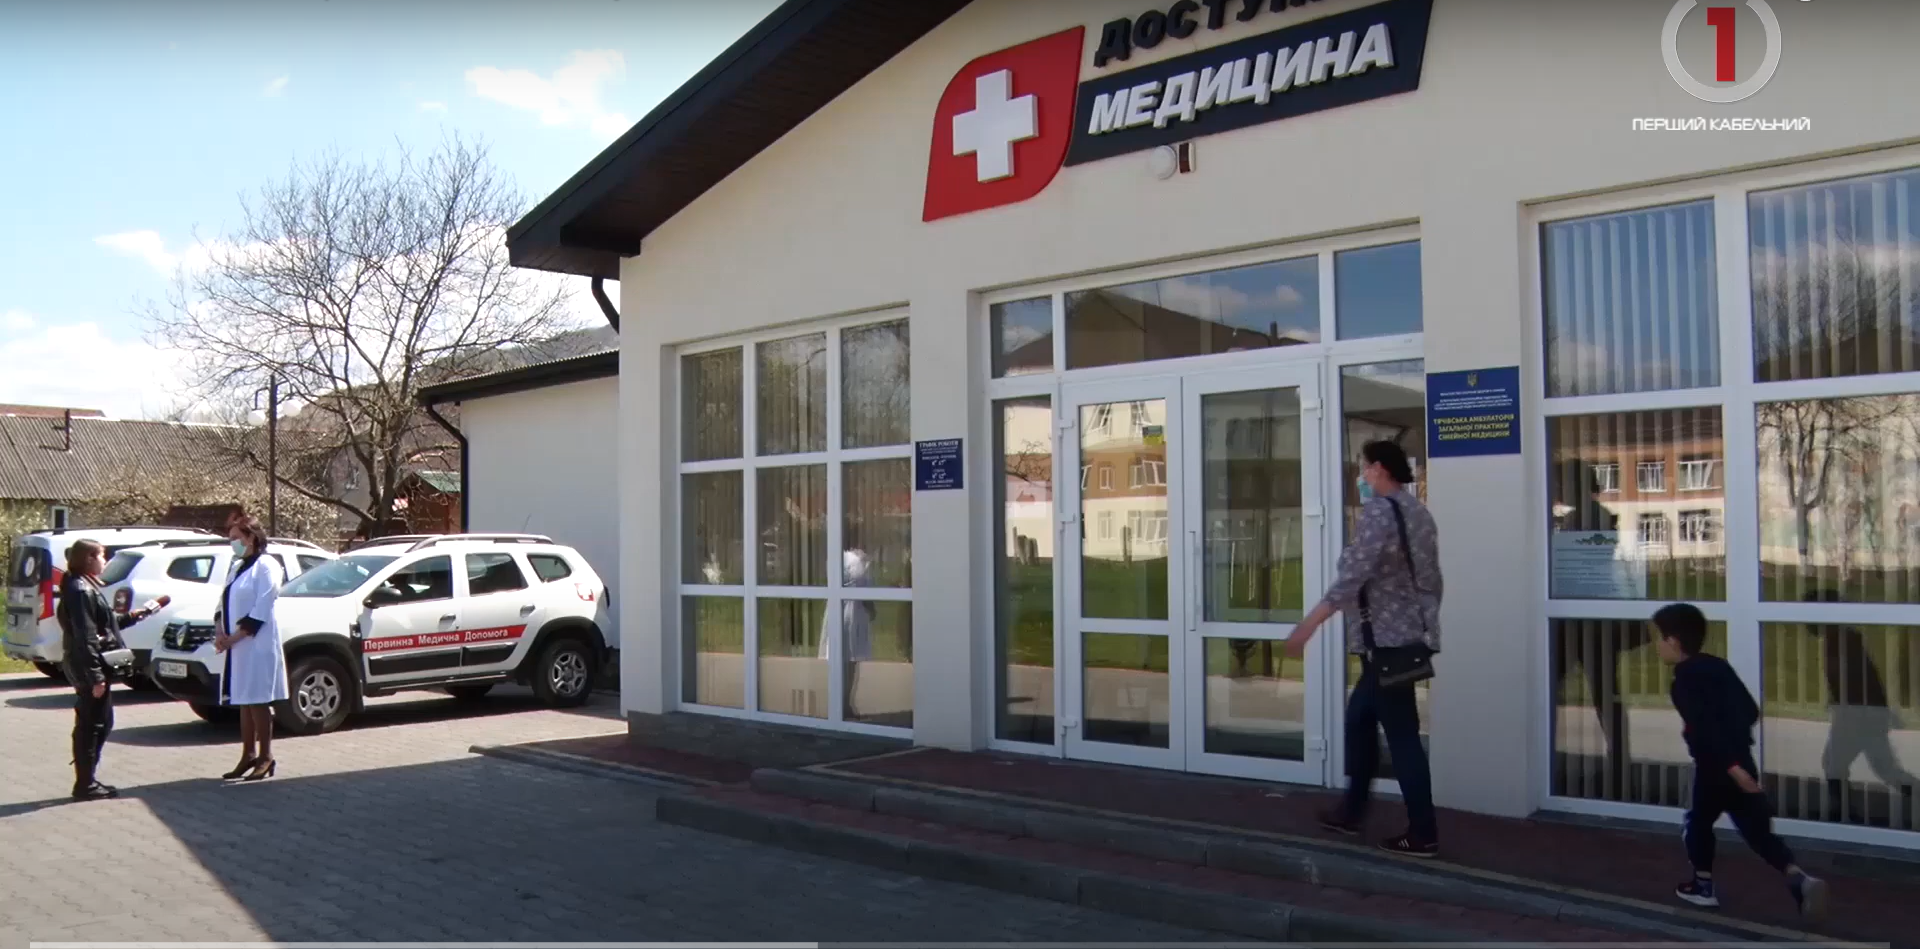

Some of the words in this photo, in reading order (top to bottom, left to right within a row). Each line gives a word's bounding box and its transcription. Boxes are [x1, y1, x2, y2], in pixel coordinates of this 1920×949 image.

[1088, 23, 1395, 135] МЕДИЦИНА
[1474, 422, 1509, 430] ПРАКТИКИ
[364, 637, 414, 651] Первинна
[418, 633, 460, 645] Медична
[464, 629, 509, 641] Допомога
